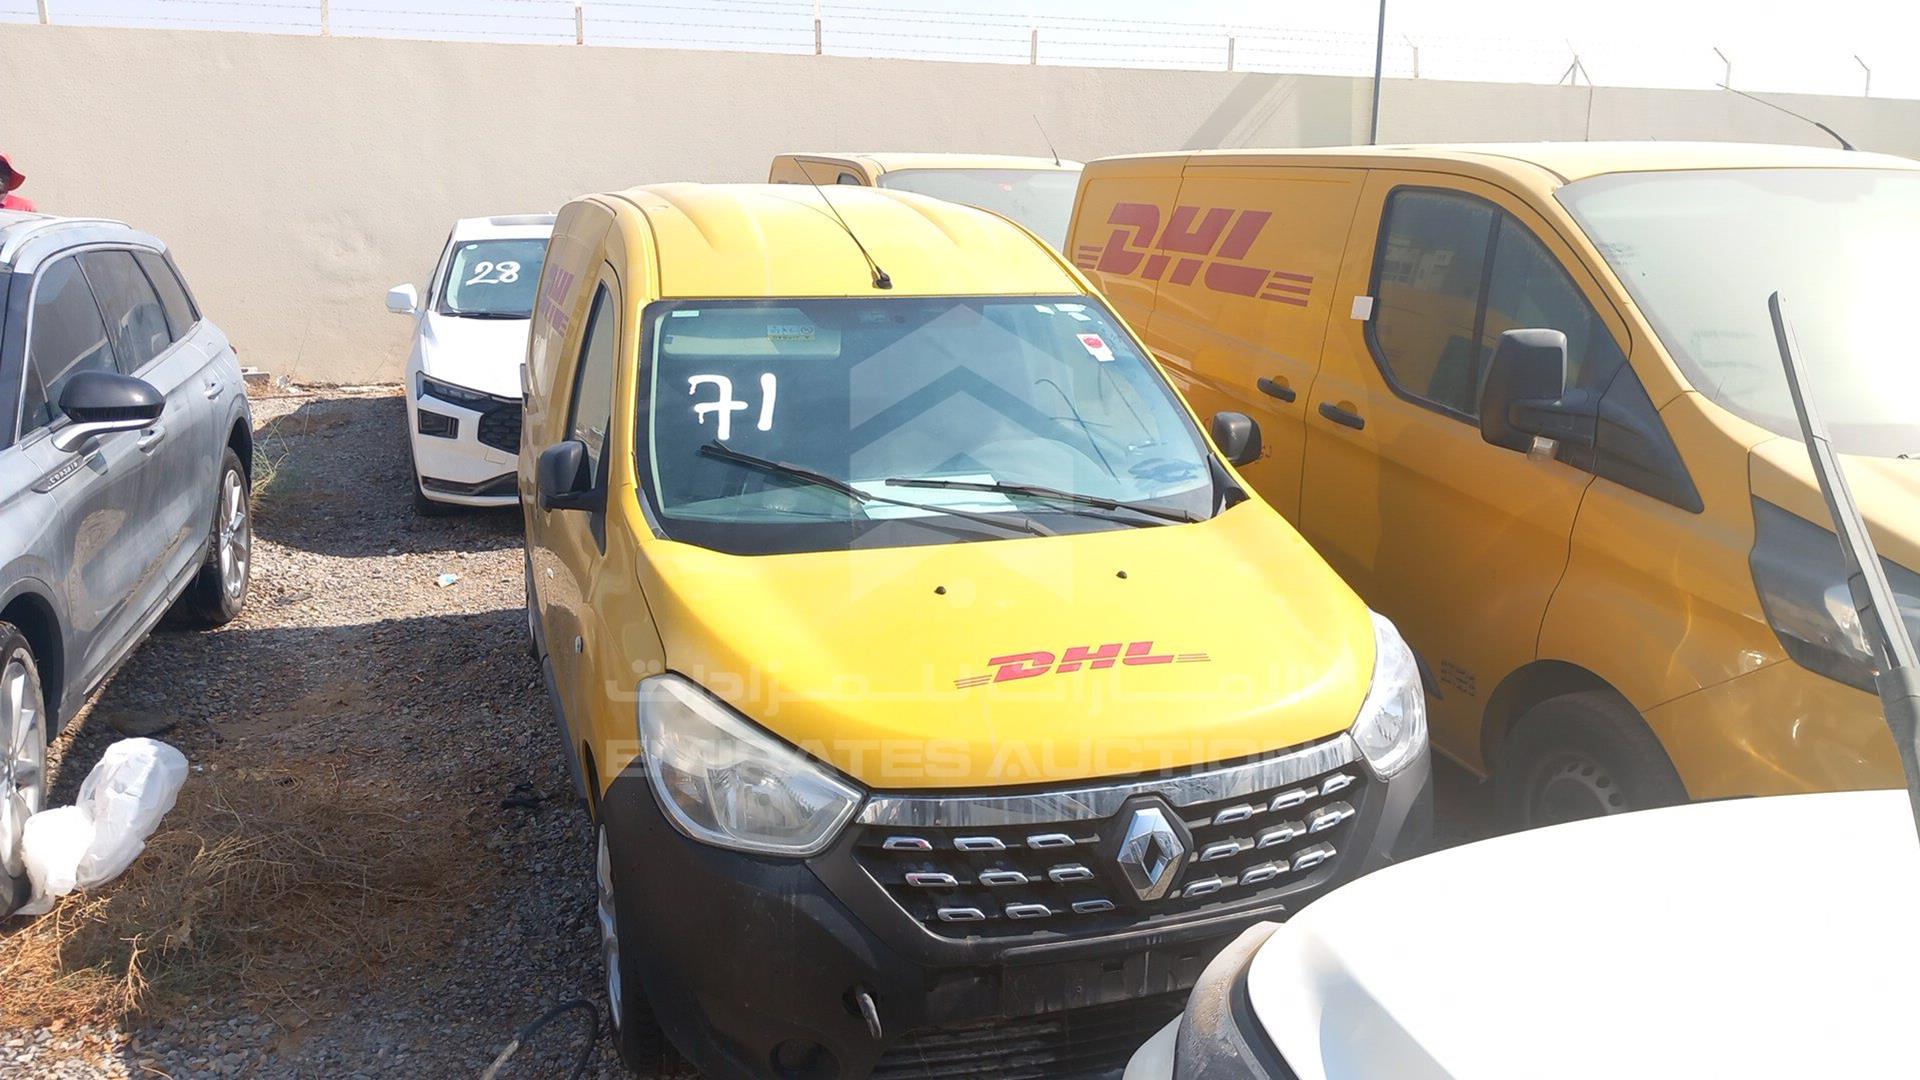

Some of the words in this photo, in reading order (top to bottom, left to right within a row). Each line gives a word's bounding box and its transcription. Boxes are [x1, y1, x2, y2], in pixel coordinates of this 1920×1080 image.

[465, 261, 521, 286] 28
[1096, 202, 1273, 298] DHL
[687, 372, 777, 441] 71
[987, 641, 1175, 683] DHL
